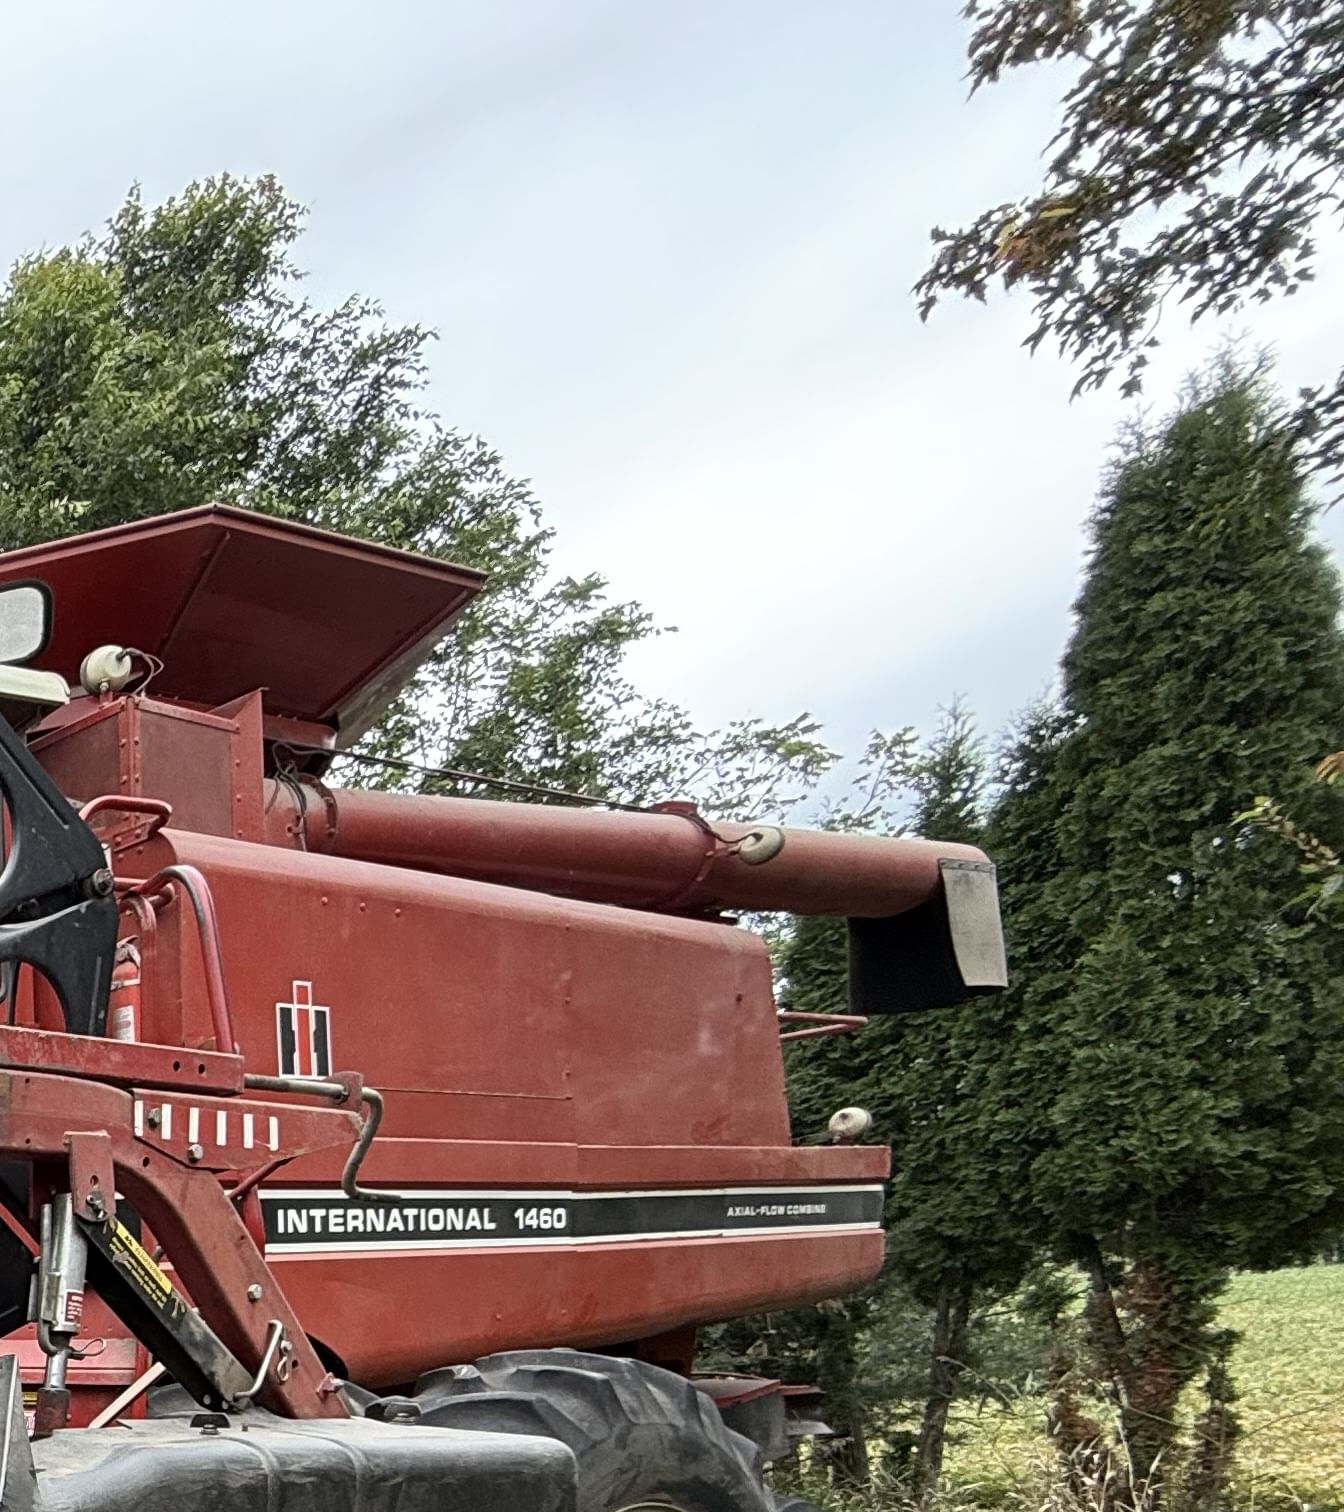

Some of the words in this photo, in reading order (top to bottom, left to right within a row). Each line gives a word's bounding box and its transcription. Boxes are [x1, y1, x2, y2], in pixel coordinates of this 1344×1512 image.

[277, 1207, 496, 1233] INTERNATIONAL
[513, 1207, 567, 1231] 1460
[727, 1204, 785, 1217] AXIAL-FLOW
